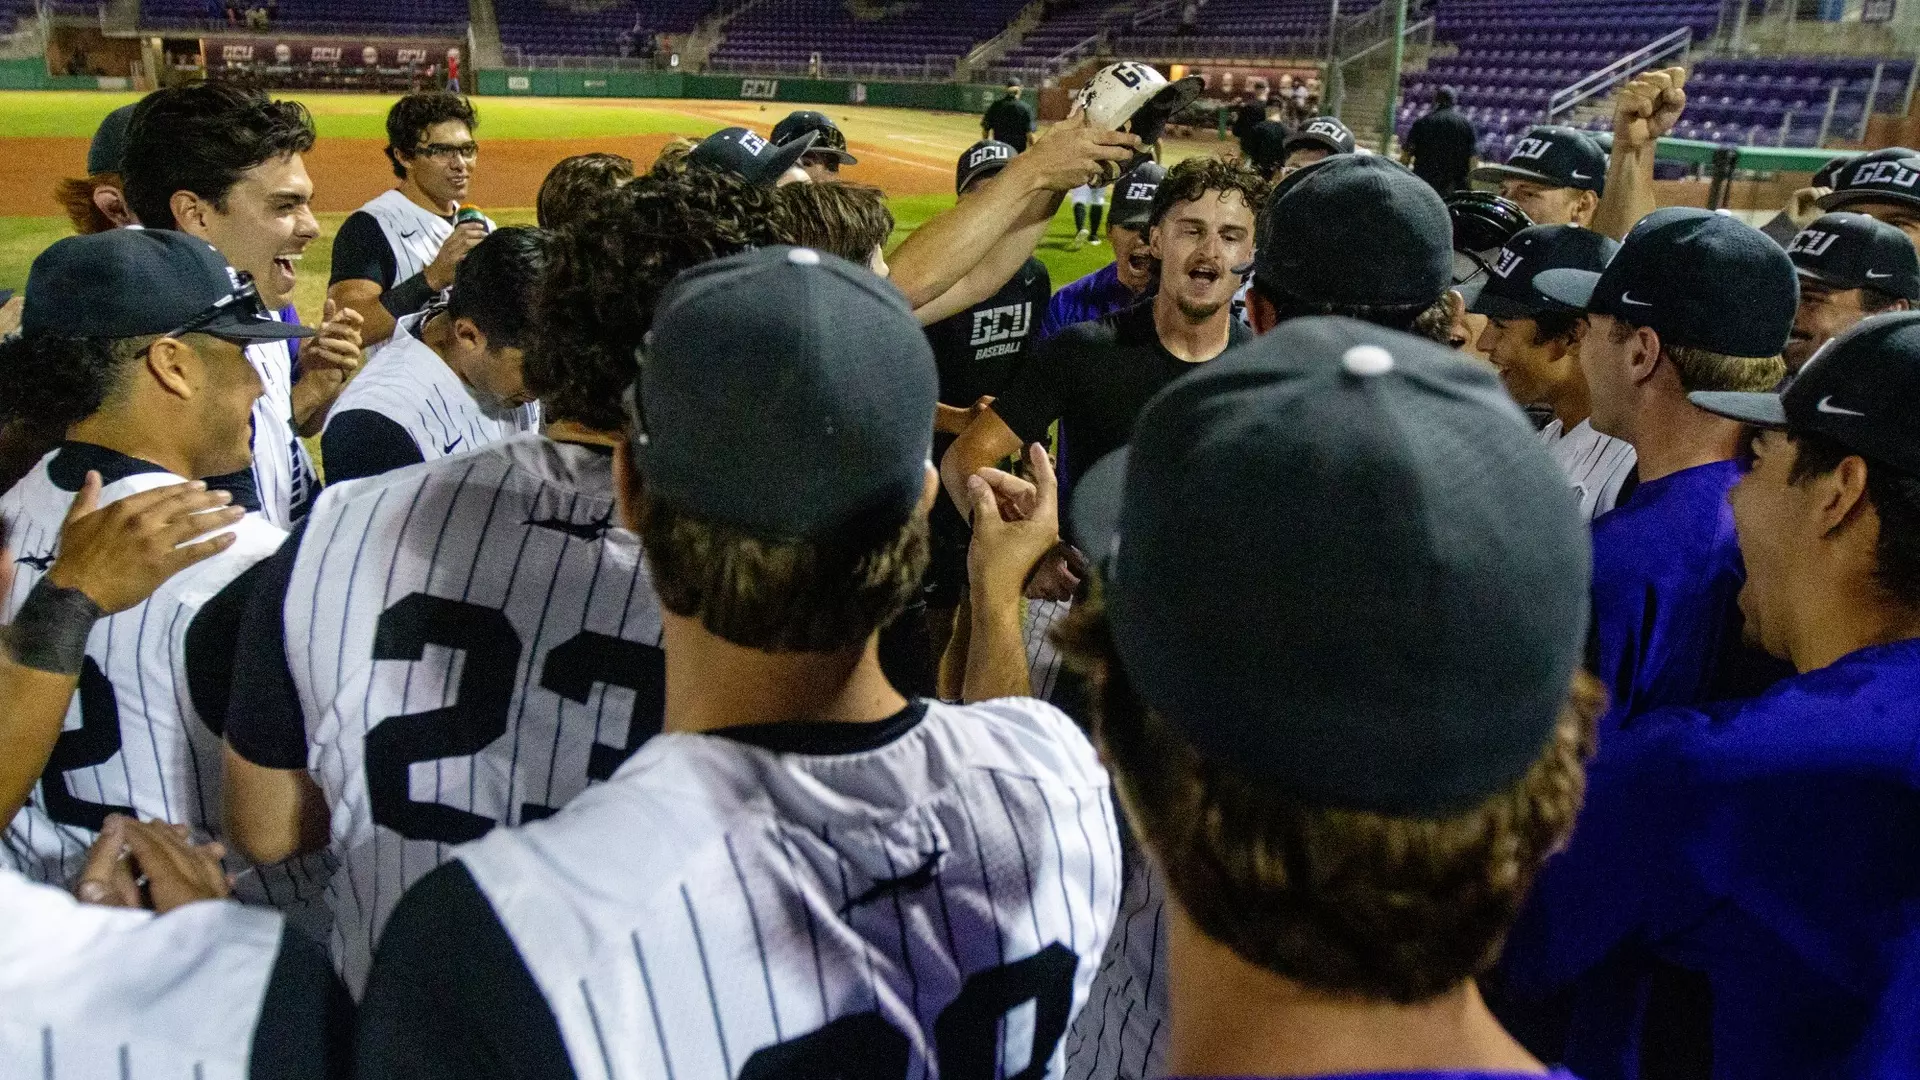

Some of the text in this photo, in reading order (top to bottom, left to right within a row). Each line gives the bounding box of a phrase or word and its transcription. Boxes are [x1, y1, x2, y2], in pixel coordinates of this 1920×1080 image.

[311, 47, 342, 61] GCU
[740, 79, 778, 98] GCU
[1305, 122, 1347, 143] GCU
[969, 146, 1008, 168] GCU
[1508, 137, 1553, 163] CU
[1850, 161, 1920, 188] GCU
[1126, 183, 1158, 200] GC
[1786, 230, 1840, 256] CU
[970, 301, 1032, 346] GCU
[975, 341, 1021, 360] BASEBALL
[32, 654, 137, 831] 2
